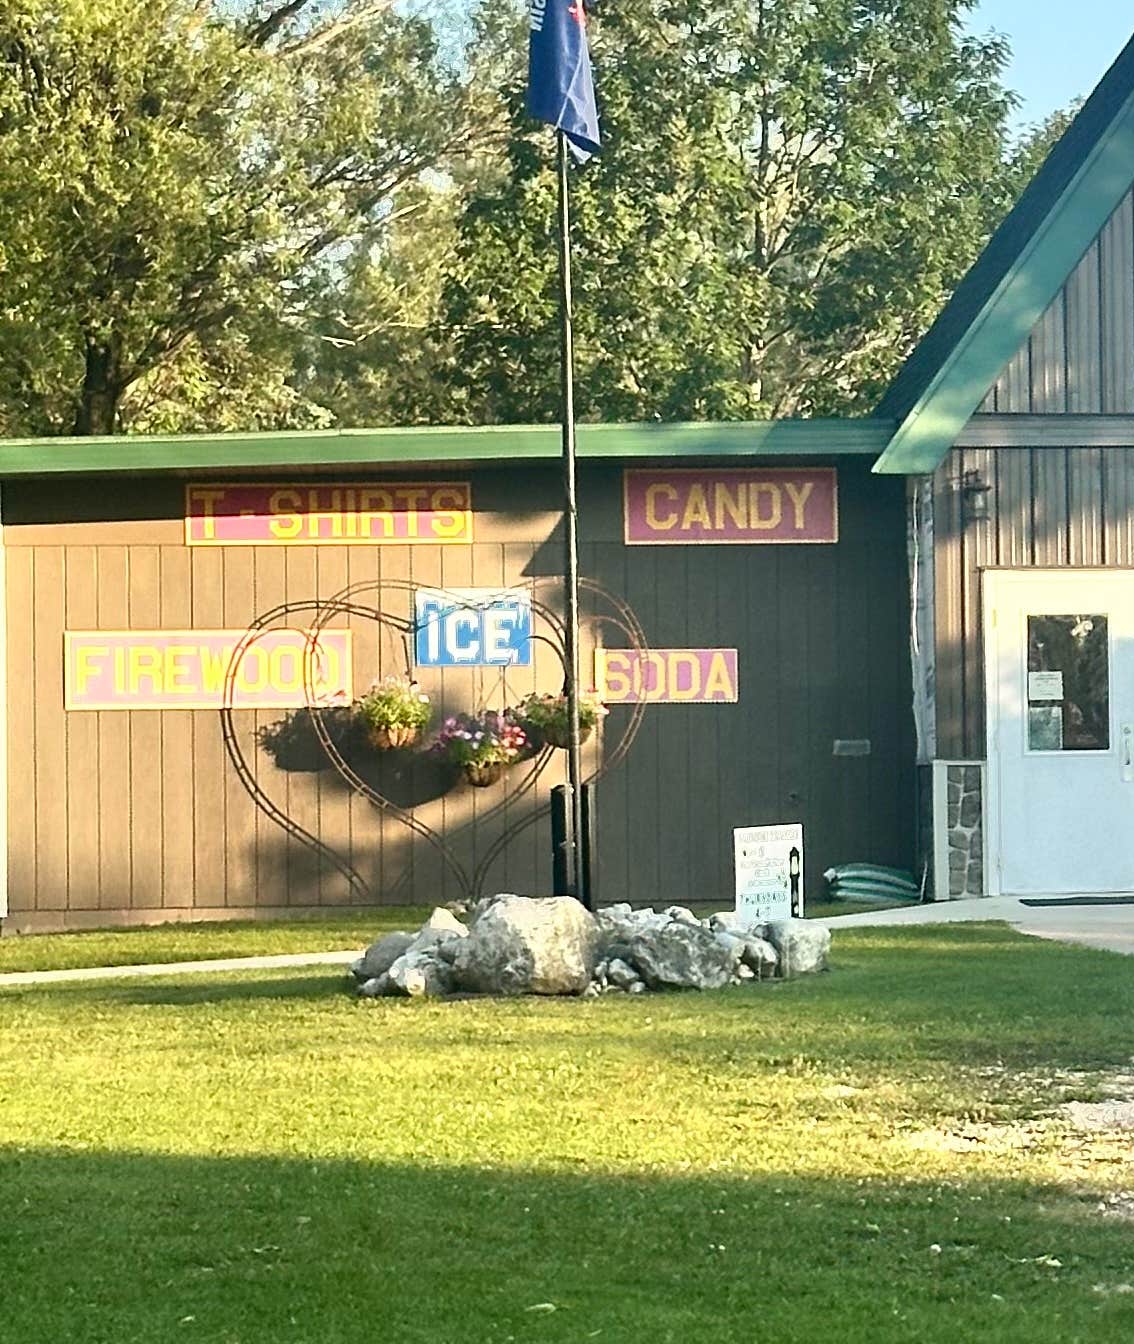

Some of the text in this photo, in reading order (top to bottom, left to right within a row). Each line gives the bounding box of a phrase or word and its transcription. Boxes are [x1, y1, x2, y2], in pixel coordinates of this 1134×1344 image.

[645, 482, 814, 530] CANDY
[425, 601, 519, 662] ICE
[75, 645, 338, 695] FIREWOOD
[605, 652, 735, 700] SODA
